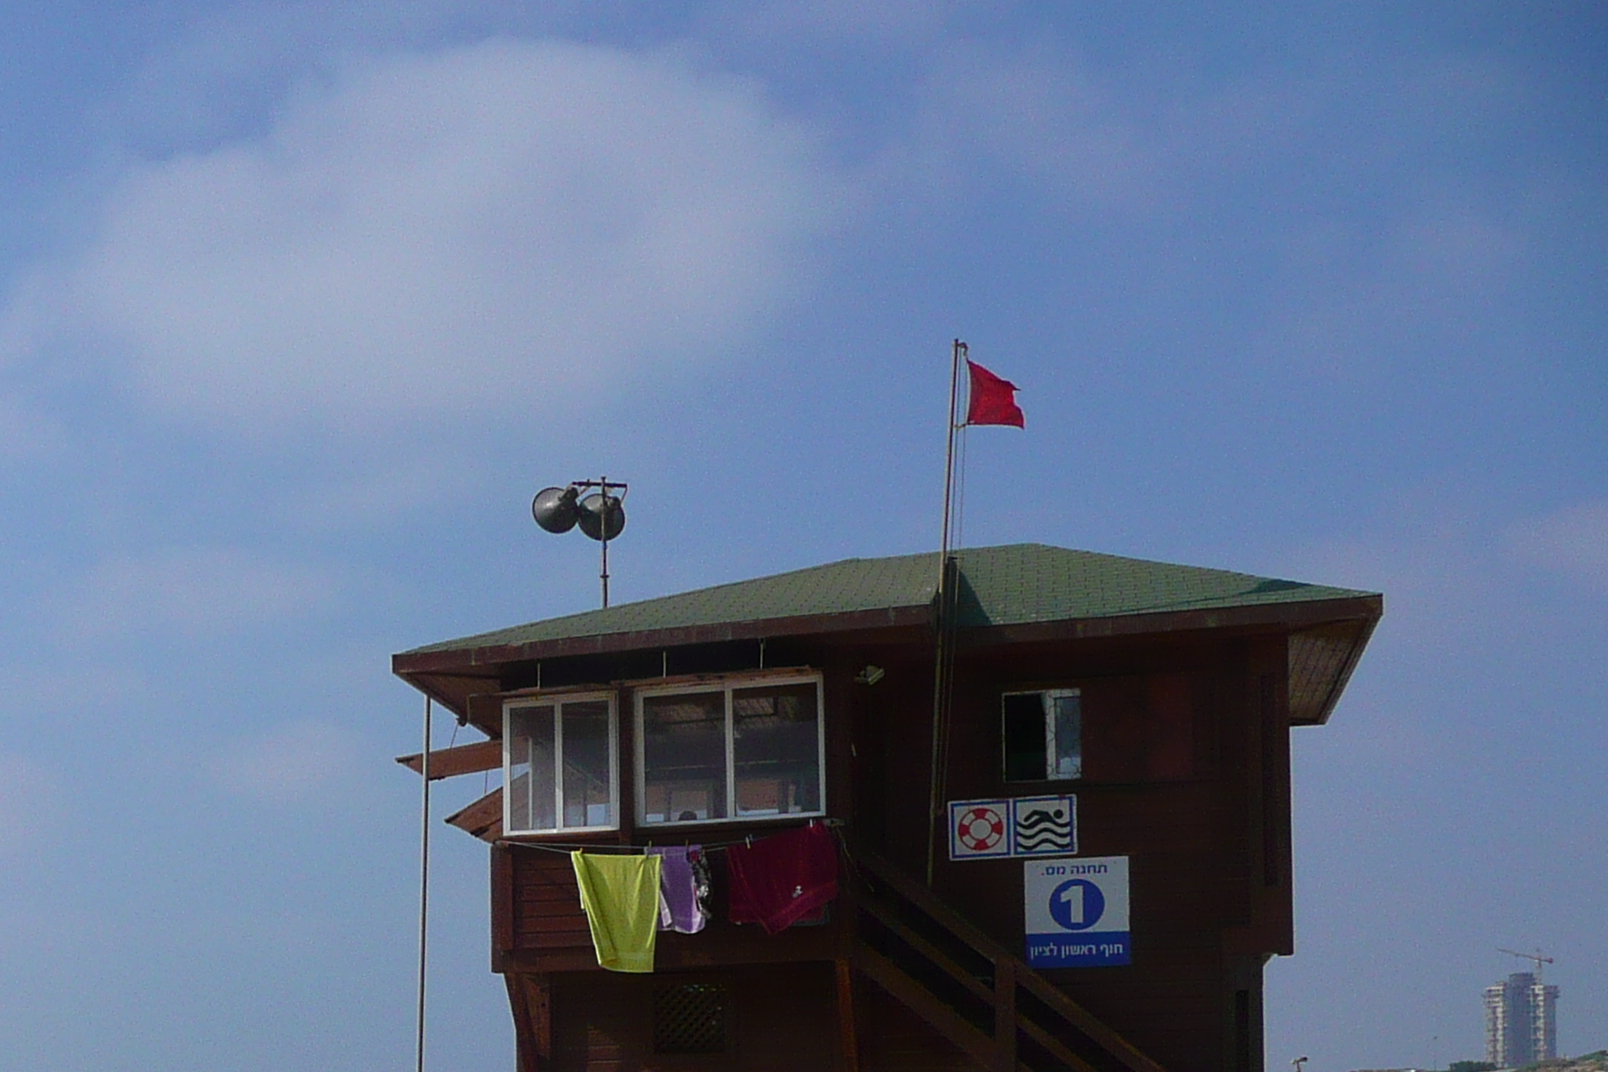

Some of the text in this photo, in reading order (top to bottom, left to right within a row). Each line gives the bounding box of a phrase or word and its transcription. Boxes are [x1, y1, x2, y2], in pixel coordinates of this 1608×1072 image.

[1070, 863, 1108, 875] תחנה
[1060, 885, 1084, 924] 1
[1030, 942, 1123, 960] חוף ראשון לציון
